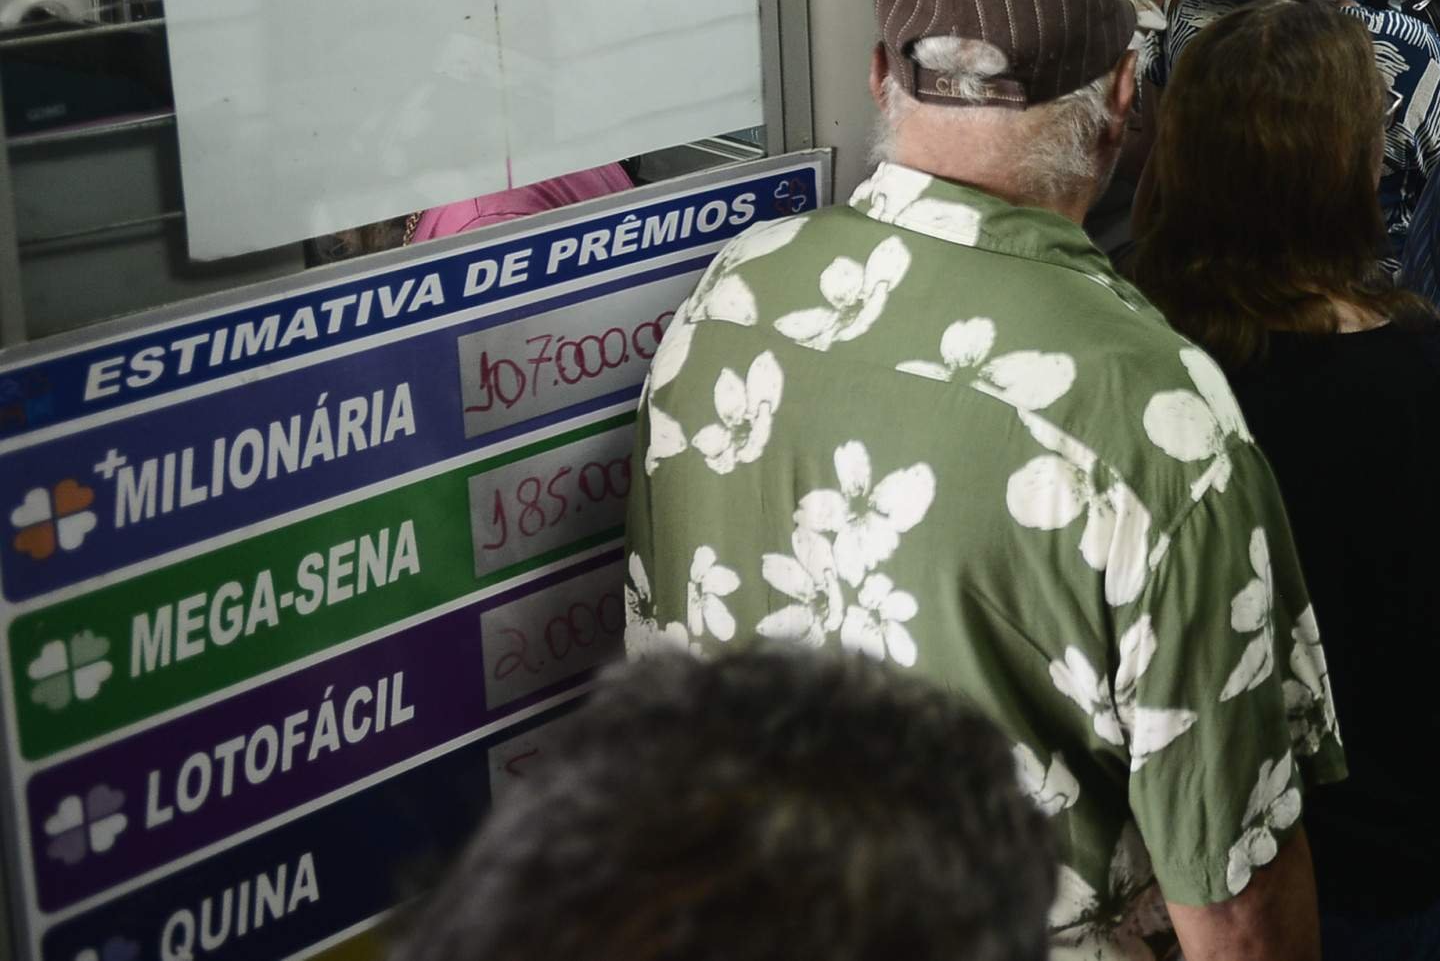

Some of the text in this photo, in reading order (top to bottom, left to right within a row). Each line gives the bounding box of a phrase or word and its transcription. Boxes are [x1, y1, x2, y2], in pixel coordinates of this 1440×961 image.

[83, 191, 757, 402] ESTIMATIVA DE PRÊMIOS
[130, 519, 421, 678] MEGA-SENA
[145, 670, 416, 830] LOTOFÁCIL
[160, 851, 320, 961] QUINA
